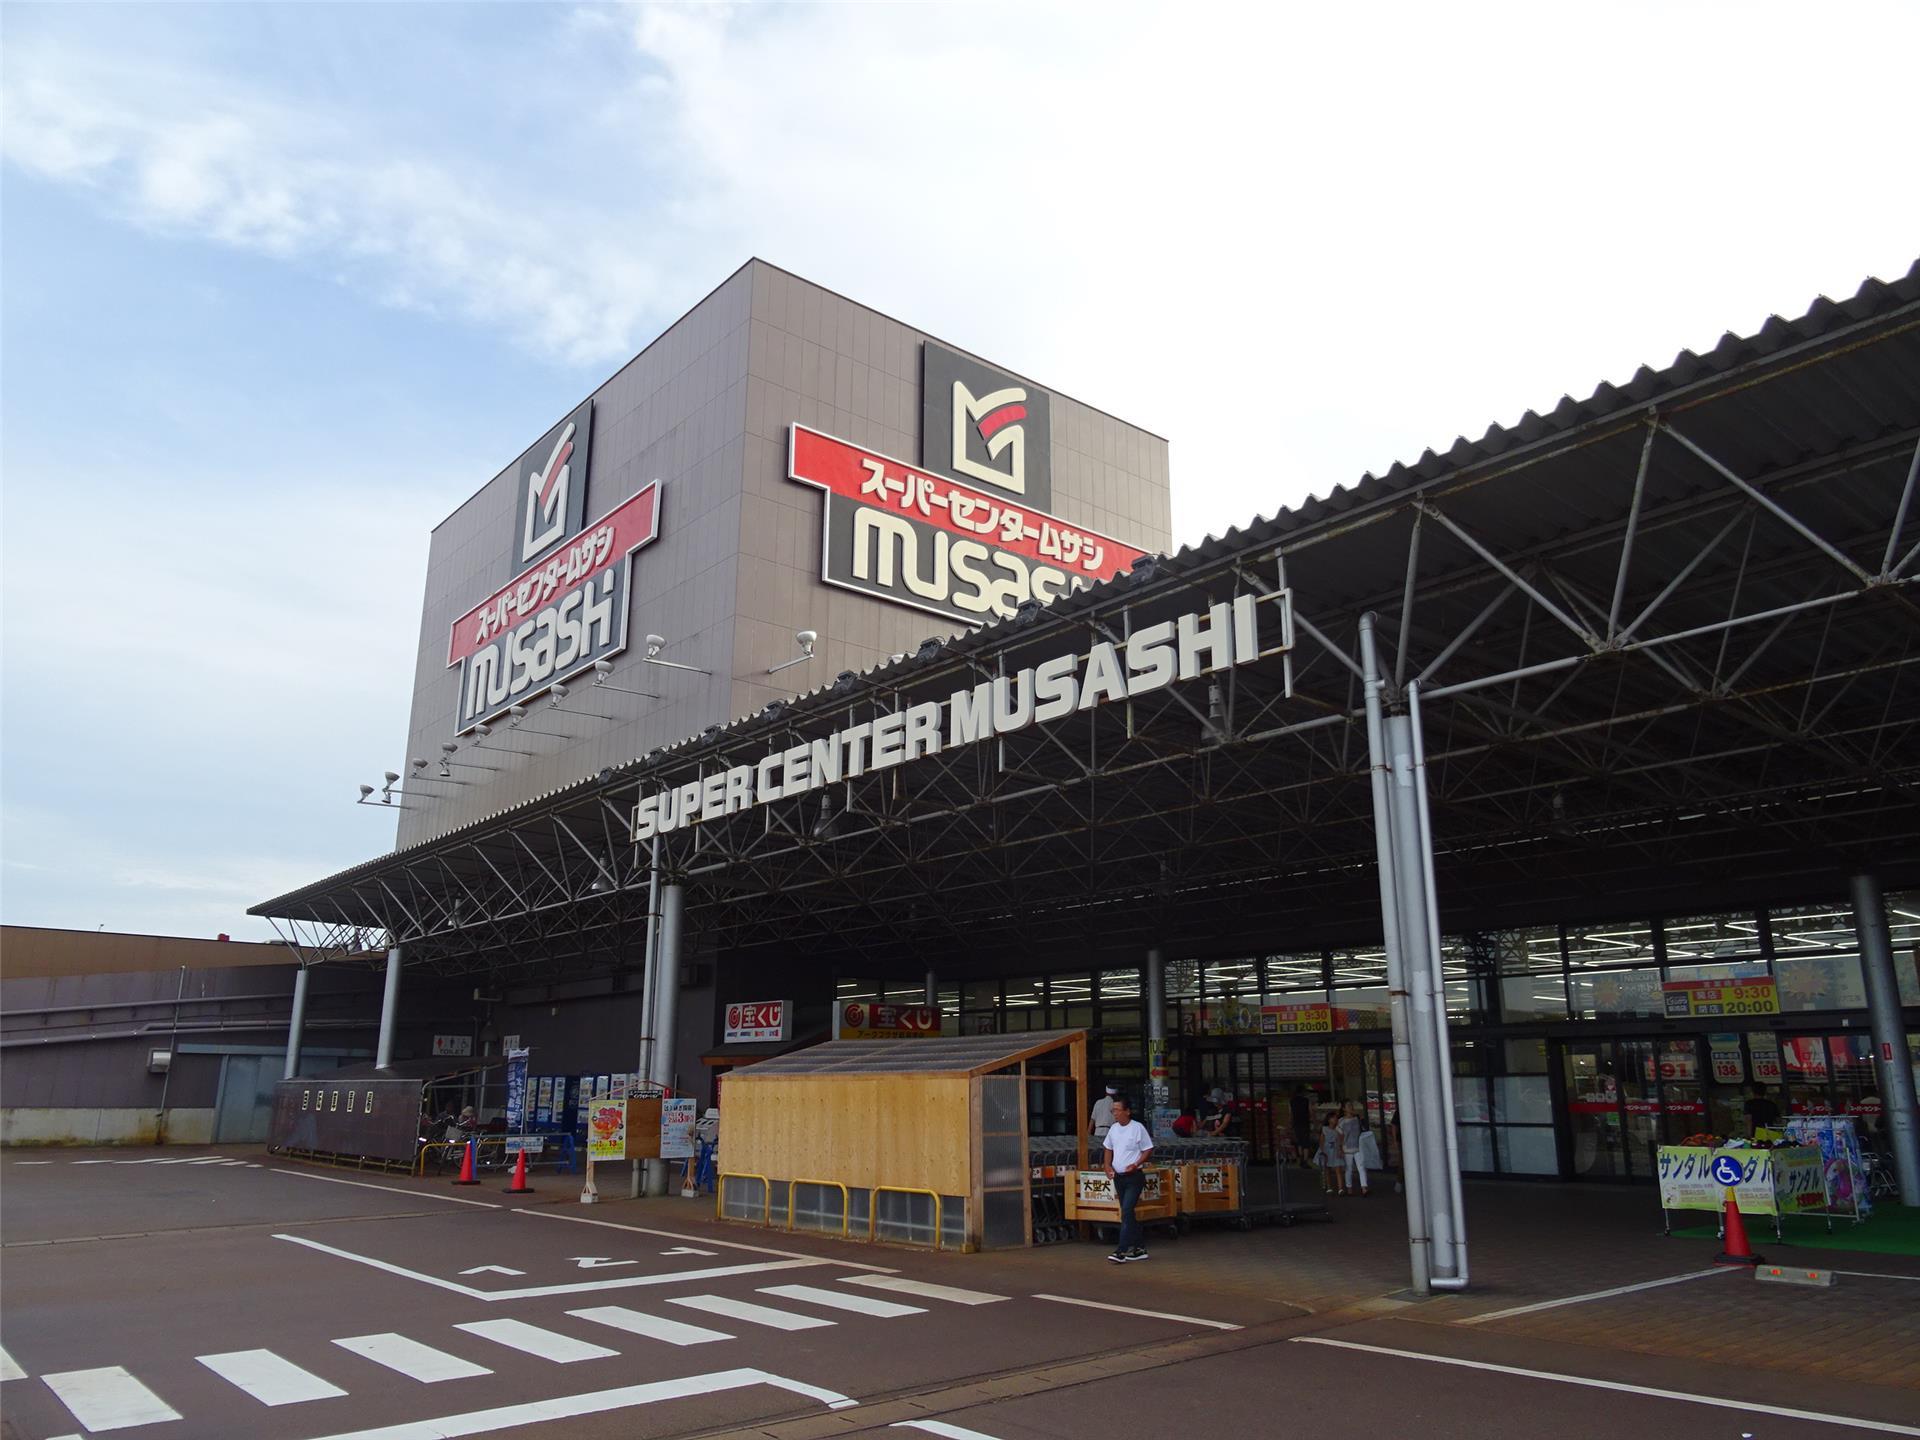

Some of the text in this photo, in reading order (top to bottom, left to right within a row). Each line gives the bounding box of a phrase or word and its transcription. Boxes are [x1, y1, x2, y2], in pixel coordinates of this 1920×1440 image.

[860, 457, 1104, 571] スーパーセンタームサシ
[475, 525, 616, 645] スーパーセンタームサシ
[465, 568, 615, 720] musashi
[636, 592, 1260, 841] SUPER CENTER MUSASHI
[1733, 986, 1771, 999] 9:30
[742, 1005, 782, 1027] 宝くじ
[877, 1005, 932, 1030] 宝くじ
[1304, 1010, 1328, 1020] 9:30
[1726, 1000, 1773, 1014] 20:00
[1300, 1021, 1328, 1032] 20:00
[1659, 1153, 1711, 1180] サンダル
[1083, 1179, 1111, 1192] 大型犬
